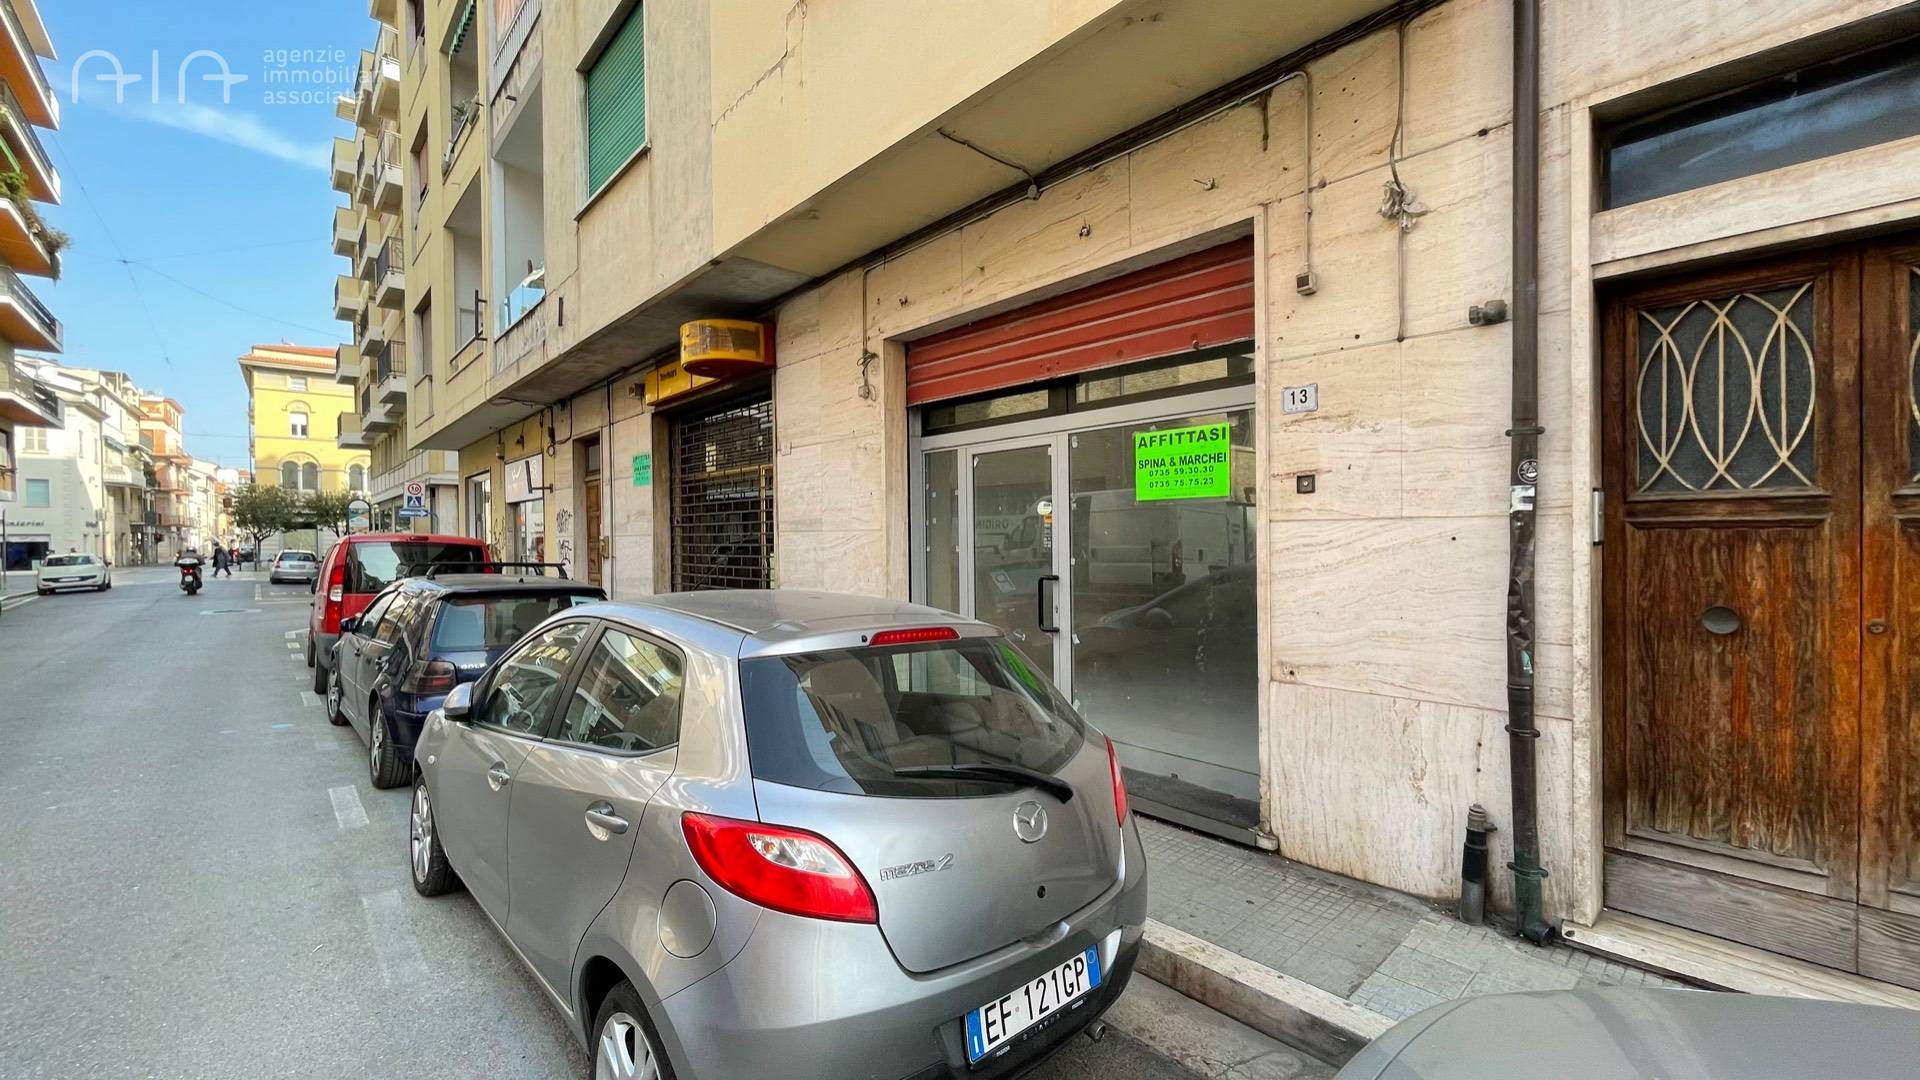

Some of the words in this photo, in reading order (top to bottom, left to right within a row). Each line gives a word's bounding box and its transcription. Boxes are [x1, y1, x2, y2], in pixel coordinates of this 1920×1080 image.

[1290, 388, 1308, 406] 13
[1138, 426, 1227, 449] AFFITTASI
[1138, 458, 1167, 470] SPINA
[1169, 456, 1176, 467] &
[1179, 452, 1227, 466] MARCHEI
[1149, 469, 1170, 477] 0735
[1174, 465, 1214, 475] 59.30.30
[1149, 480, 1170, 488] 0735
[1174, 477, 1214, 487] 75.75.23
[984, 995, 1012, 1046] EF
[1023, 956, 1085, 1021] 121GP
